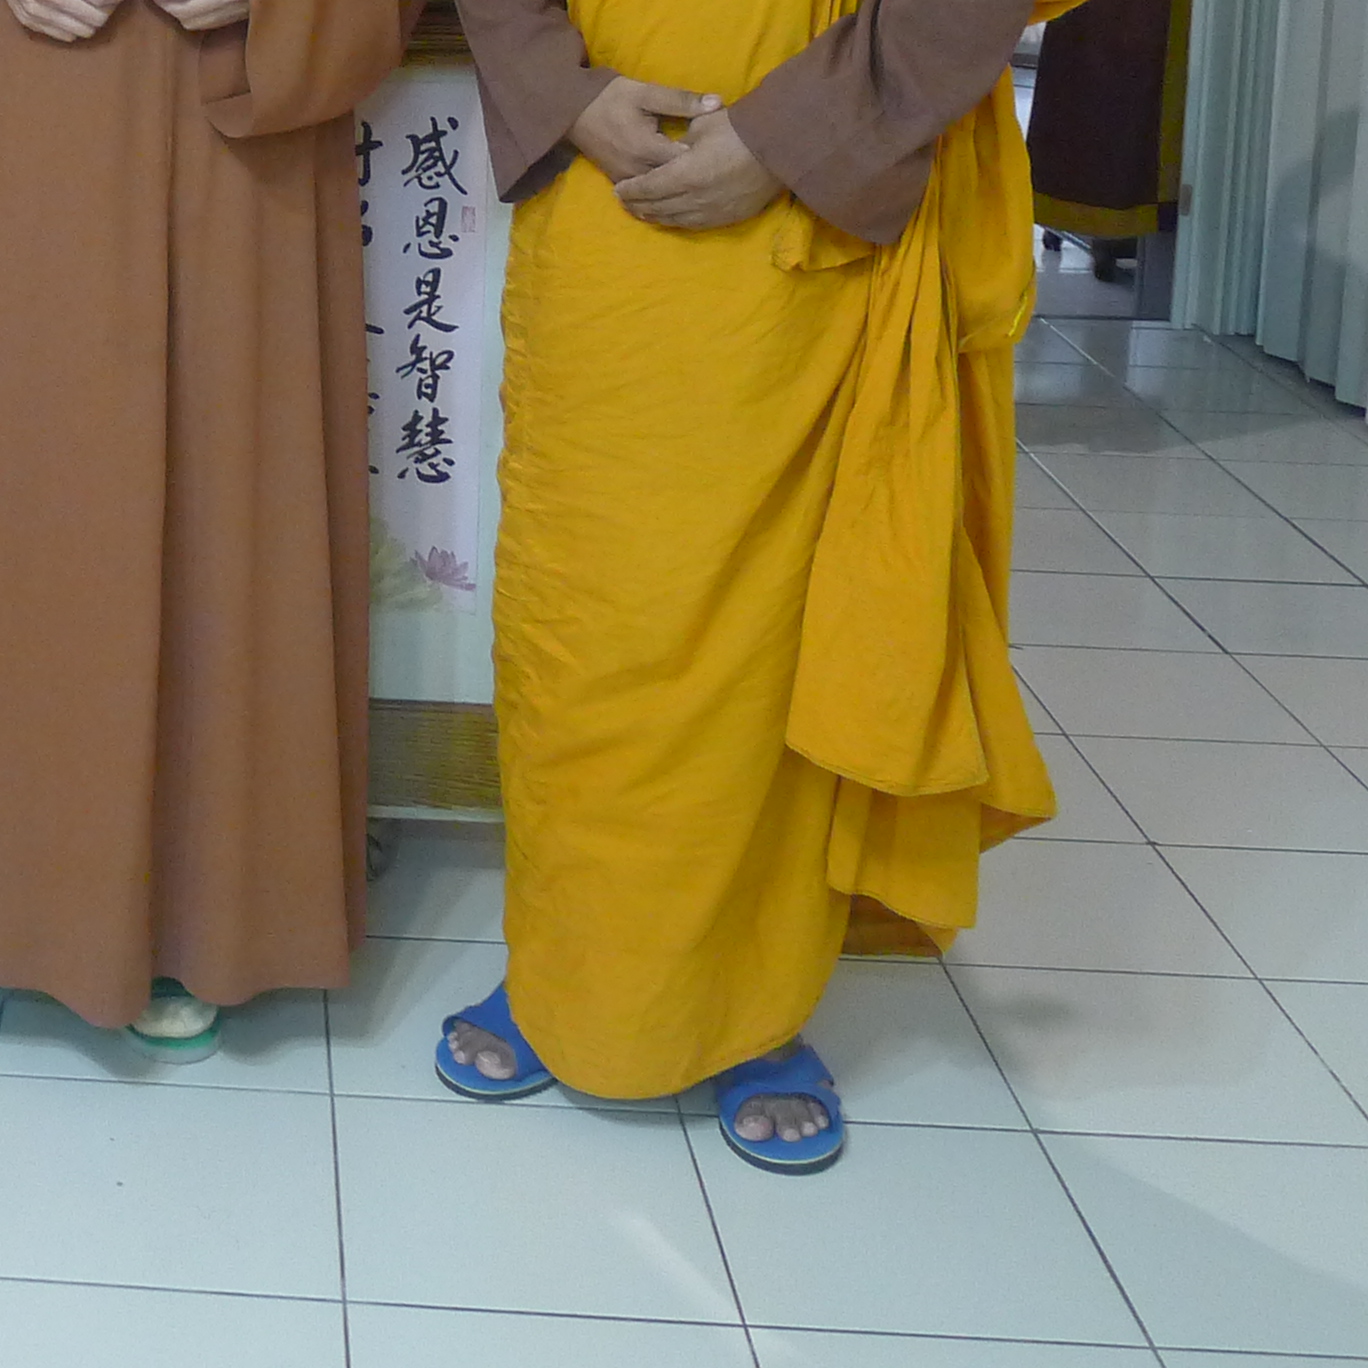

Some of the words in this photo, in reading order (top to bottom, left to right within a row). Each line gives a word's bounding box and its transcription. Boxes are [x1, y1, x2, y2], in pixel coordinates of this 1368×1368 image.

[395, 116, 468, 484] 感恩是智慧
